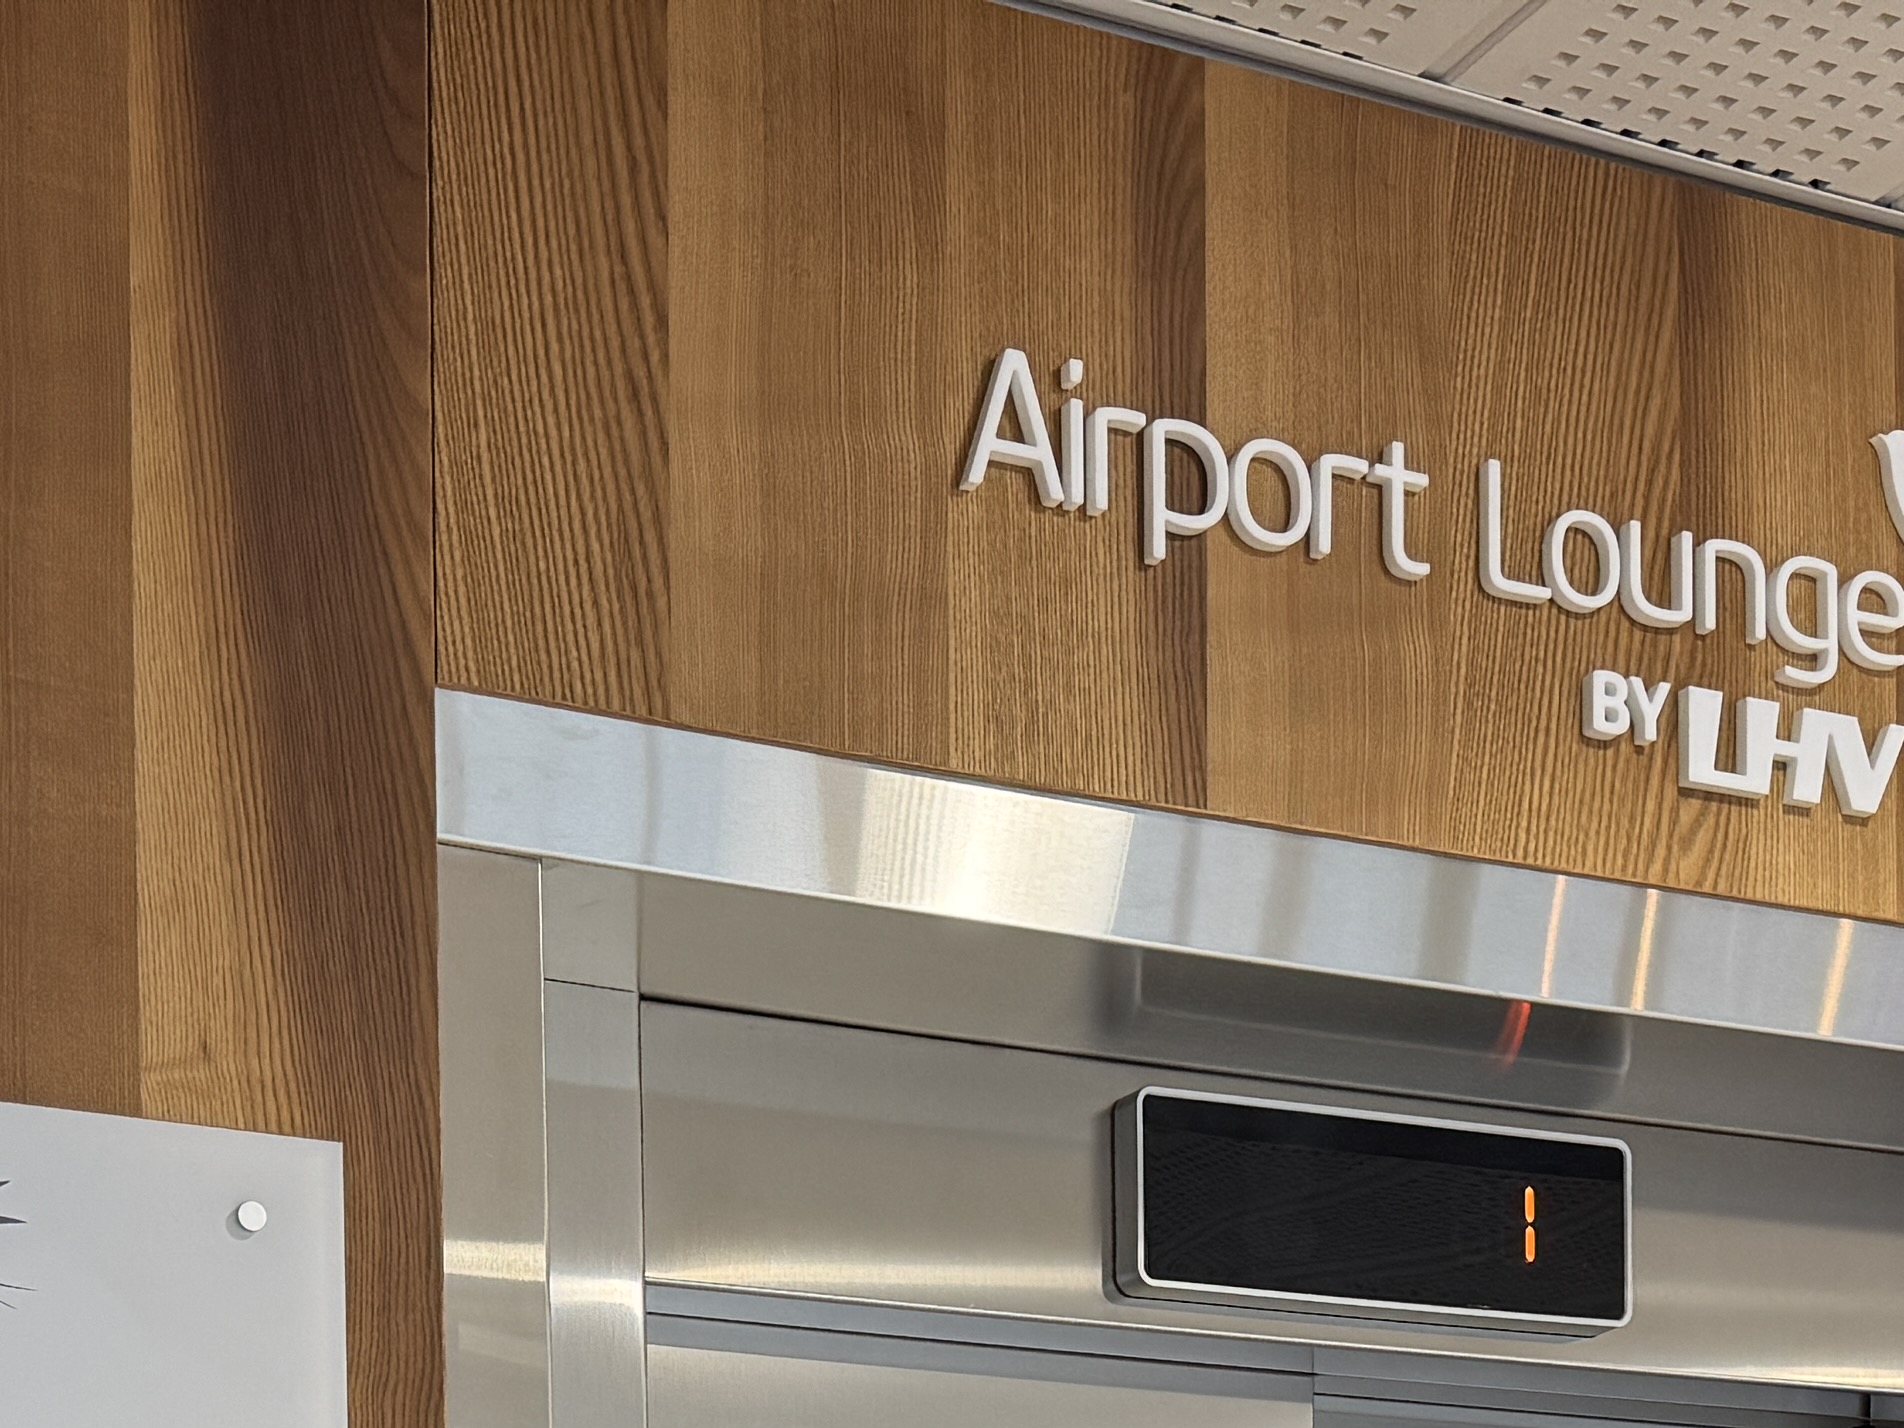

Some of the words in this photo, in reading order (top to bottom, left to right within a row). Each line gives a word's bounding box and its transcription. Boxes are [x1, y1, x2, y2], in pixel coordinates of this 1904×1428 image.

[959, 347, 1431, 582] Airport
[1583, 670, 1670, 745] BY
[1524, 1185, 1536, 1264] 1
